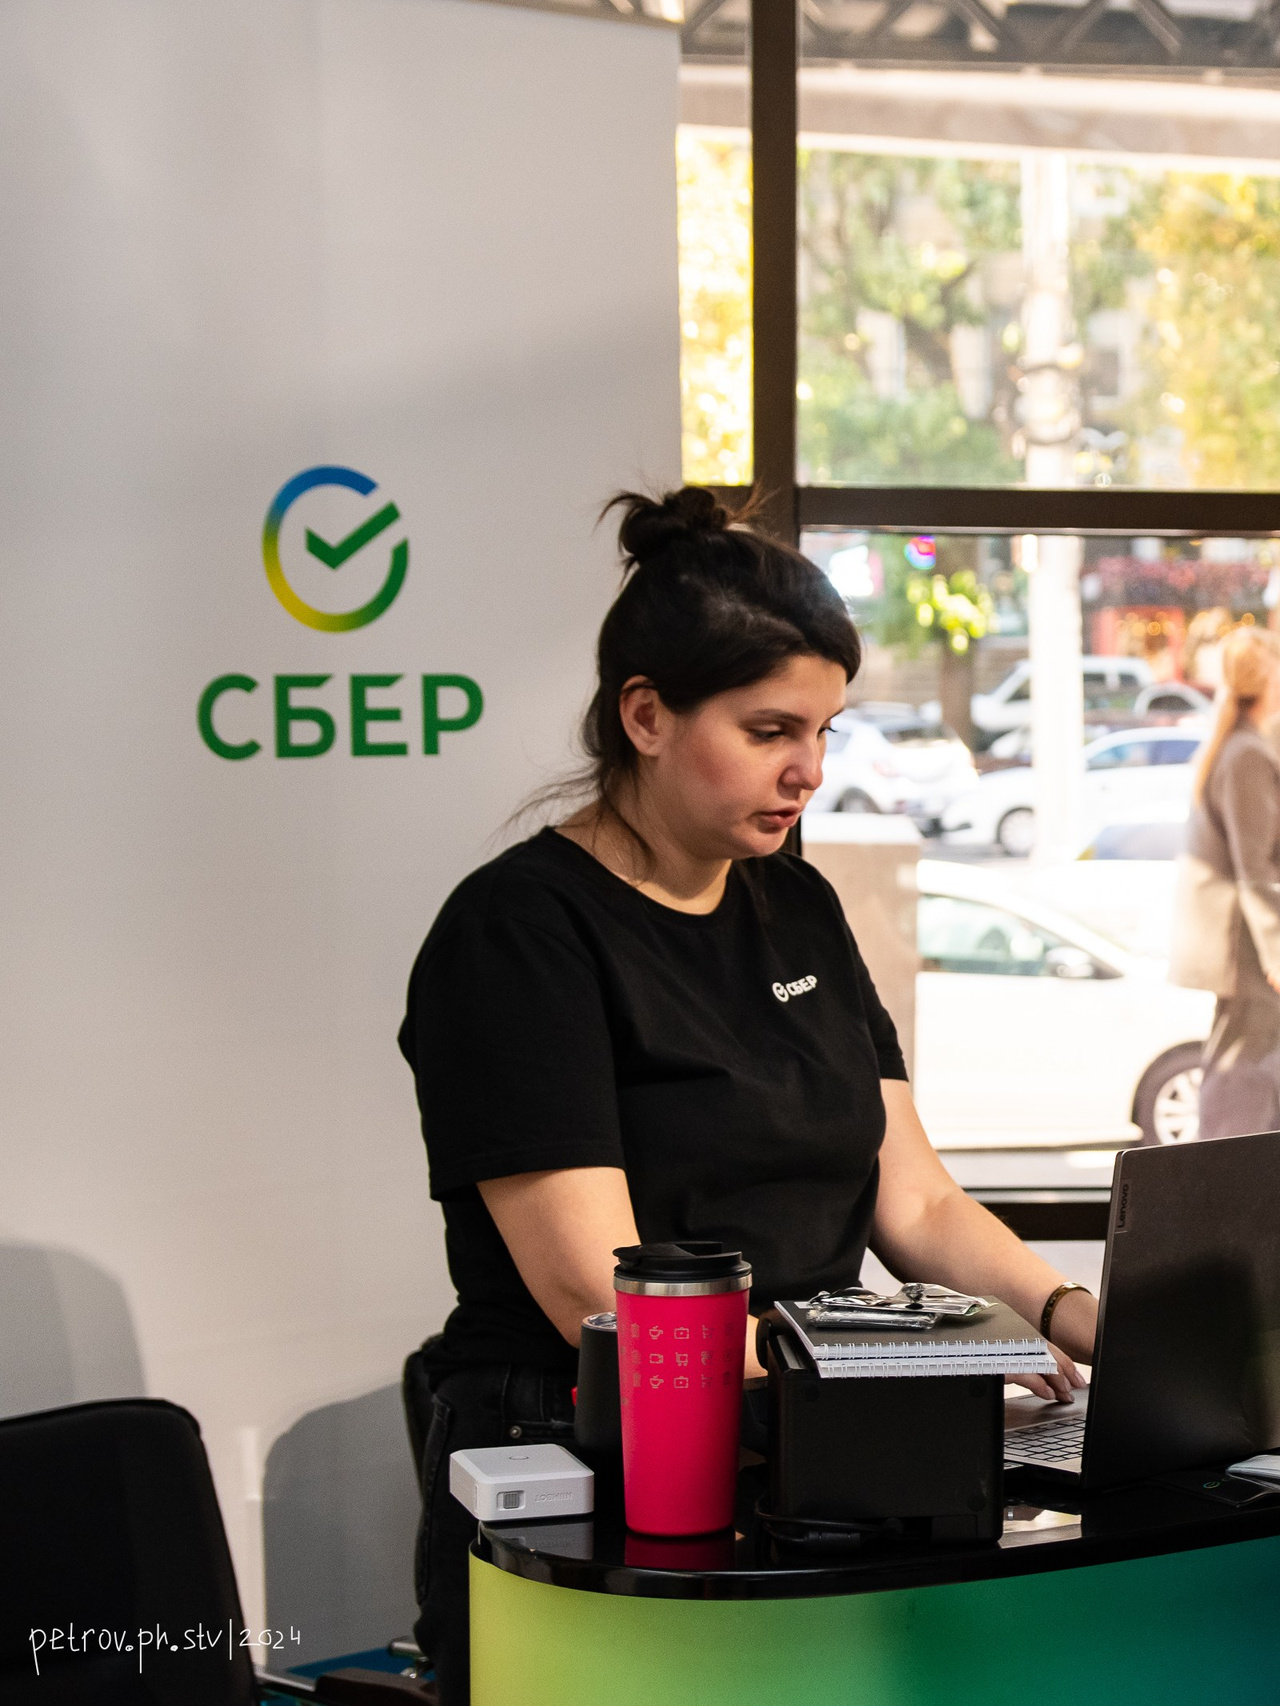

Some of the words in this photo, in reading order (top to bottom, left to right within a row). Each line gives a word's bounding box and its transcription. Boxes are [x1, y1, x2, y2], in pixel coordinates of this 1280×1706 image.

[197, 673, 484, 761] СБЕР
[786, 975, 818, 996] СБЕР
[1117, 1184, 1128, 1228] Lenovo
